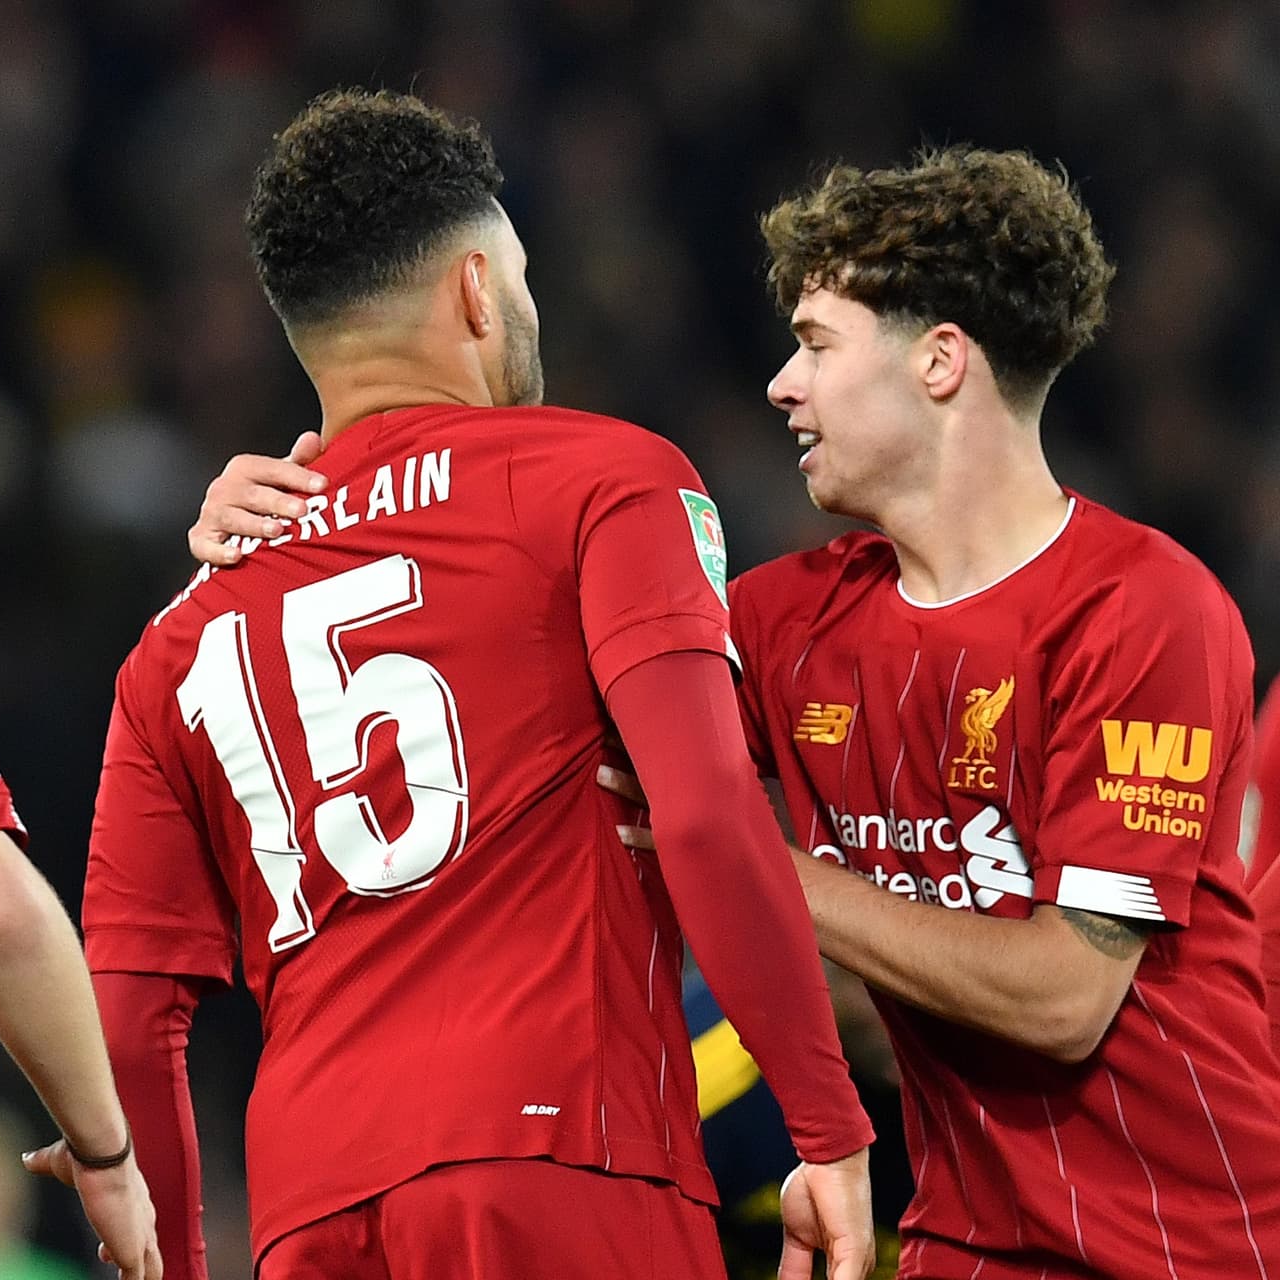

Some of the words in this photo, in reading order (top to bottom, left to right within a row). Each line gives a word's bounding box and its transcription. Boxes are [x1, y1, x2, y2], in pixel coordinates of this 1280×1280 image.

[176, 554, 470, 954] 15
[1101, 719, 1213, 784] WU
[1095, 777, 1207, 814] Western
[1123, 804, 1203, 841] Union
